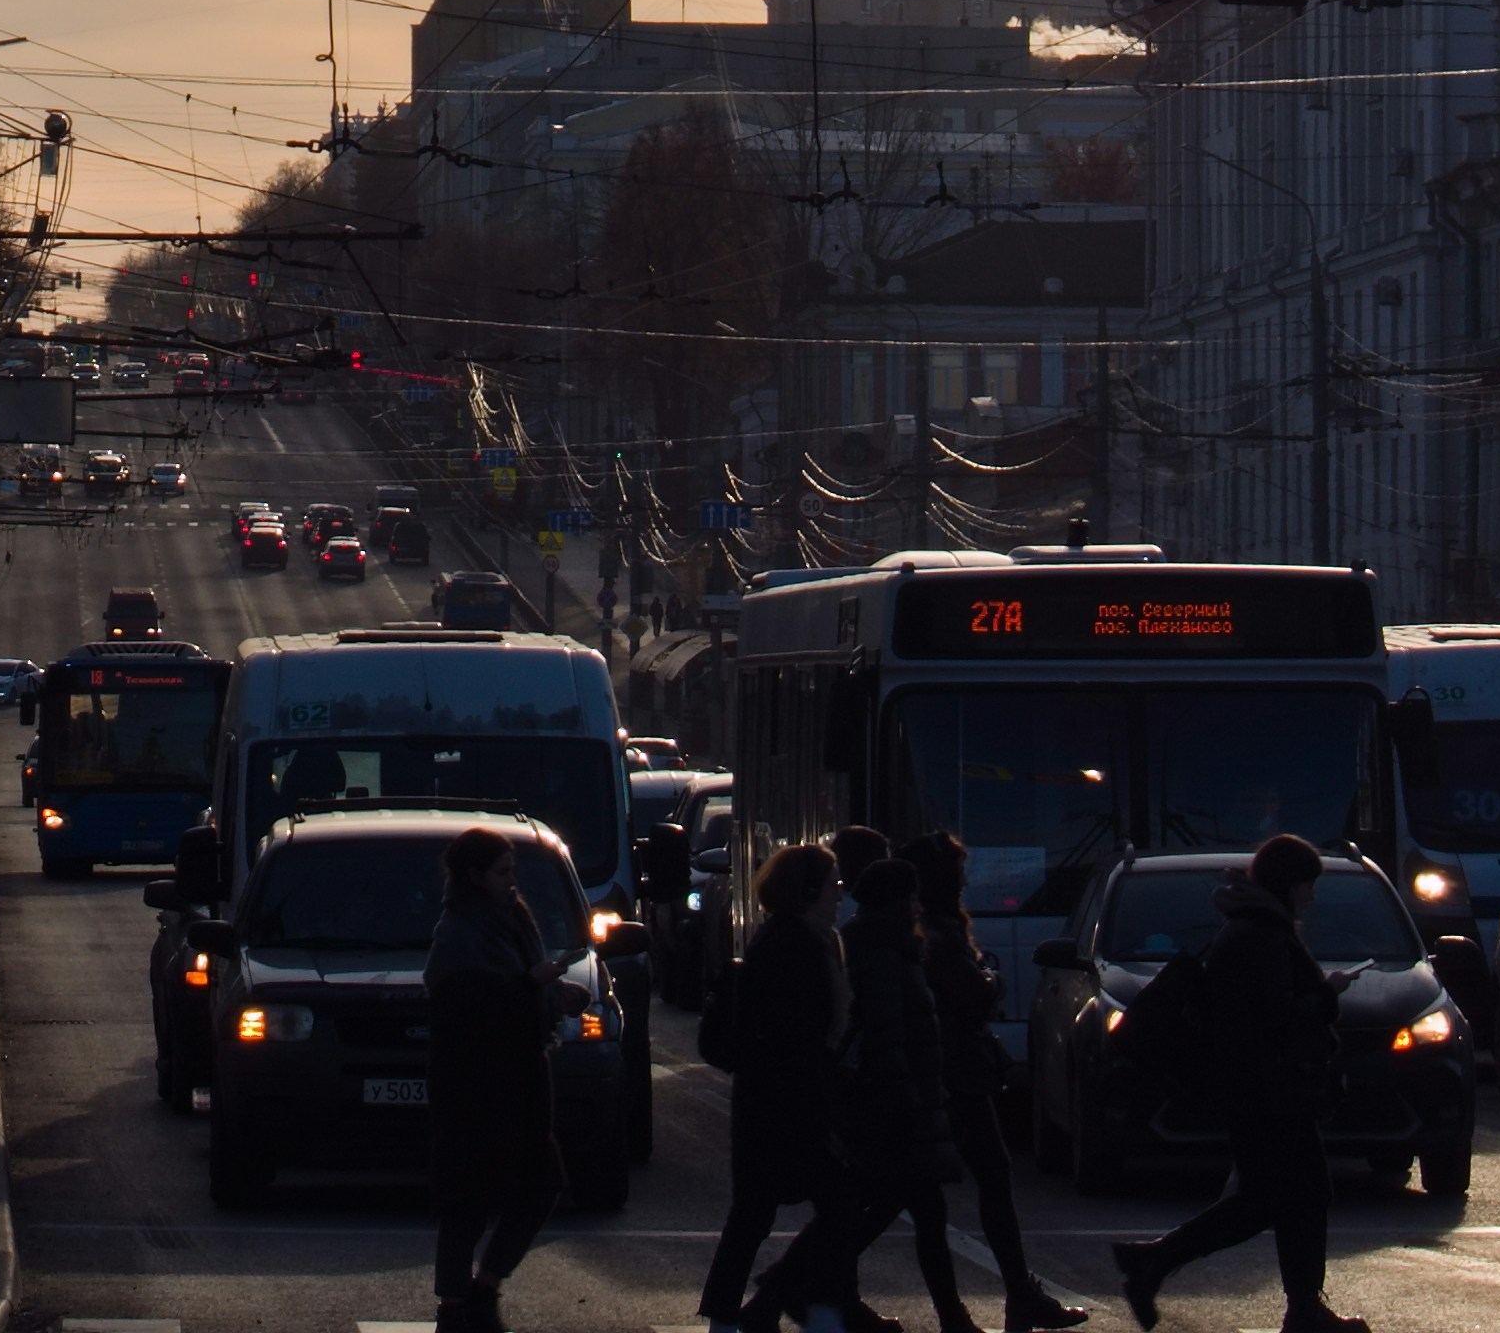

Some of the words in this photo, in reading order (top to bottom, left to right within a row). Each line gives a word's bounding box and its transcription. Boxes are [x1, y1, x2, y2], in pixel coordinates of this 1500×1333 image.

[803, 499, 820, 512] 50
[1098, 603, 1136, 618] пос.
[1142, 602, 1232, 619] Северный
[1094, 621, 1131, 634] пос.
[1138, 619, 1234, 635] Плеханово
[1433, 686, 1466, 701] 30
[290, 704, 329, 723] 62
